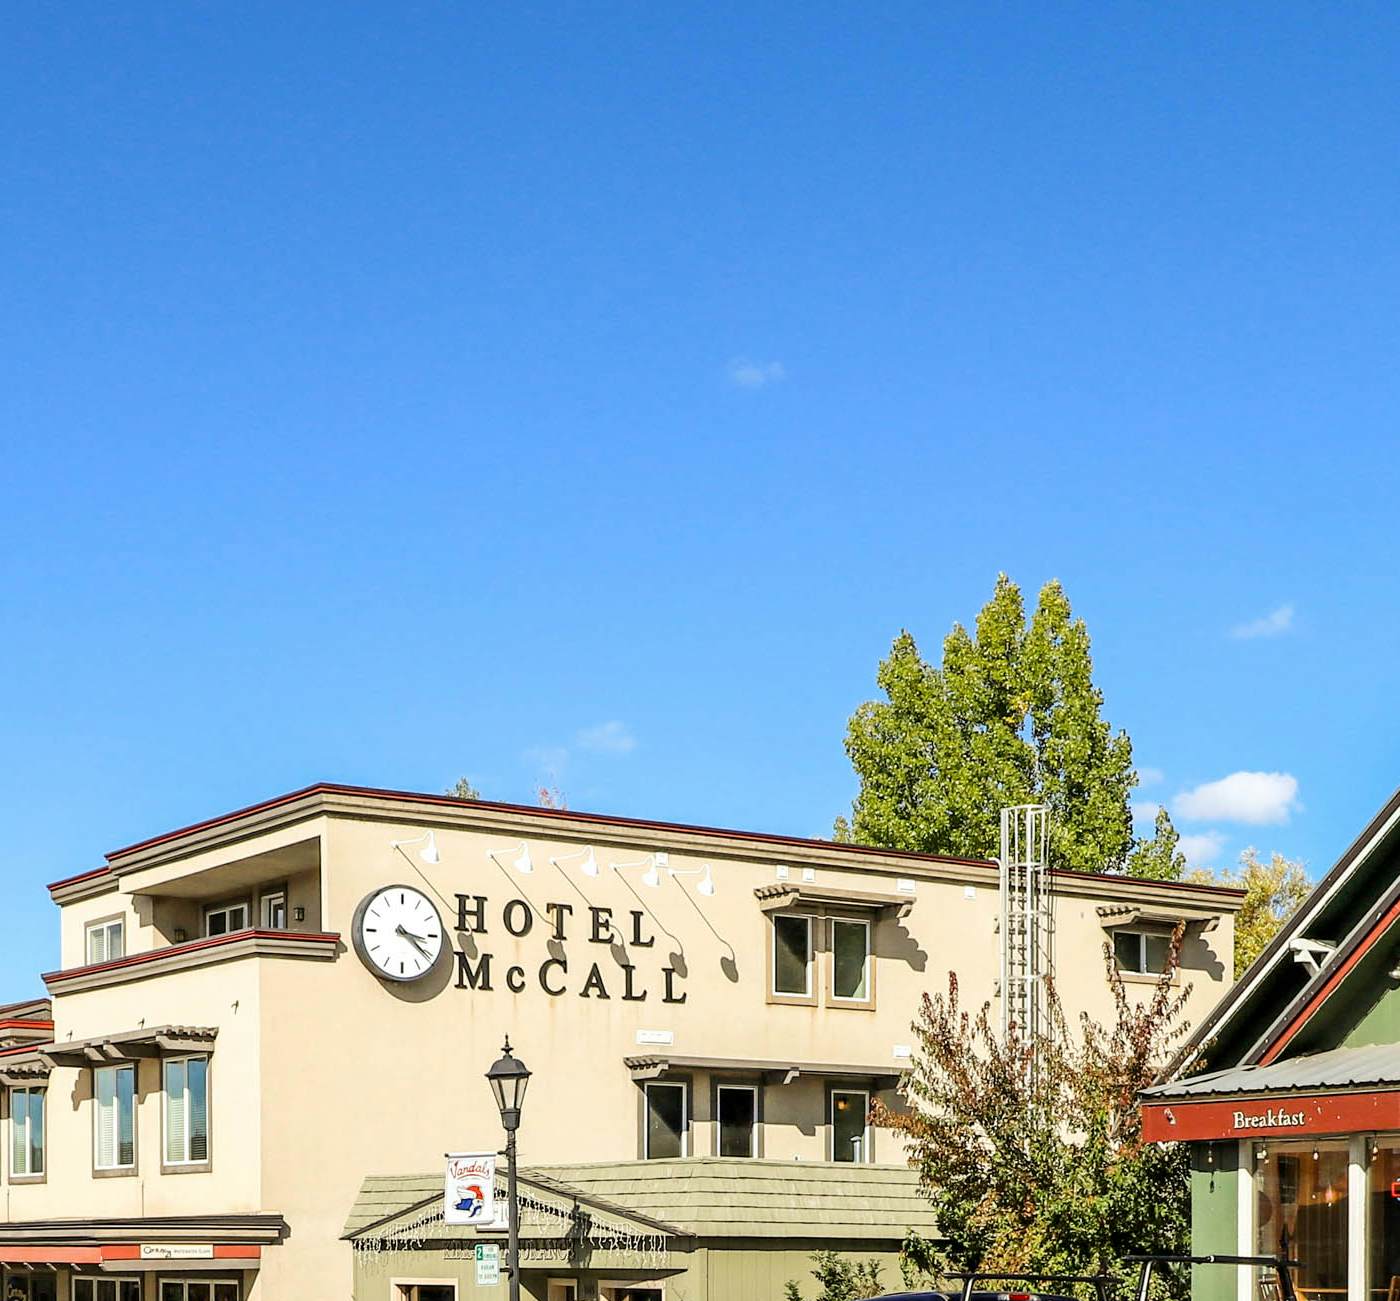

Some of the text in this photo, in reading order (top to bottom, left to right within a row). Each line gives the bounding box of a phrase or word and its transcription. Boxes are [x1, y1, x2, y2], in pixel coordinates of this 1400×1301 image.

[454, 893, 655, 947] HOTEL
[453, 951, 687, 1004] McCALL
[1233, 1108, 1305, 1129] Breakfast
[450, 1160, 490, 1178] Vandals
